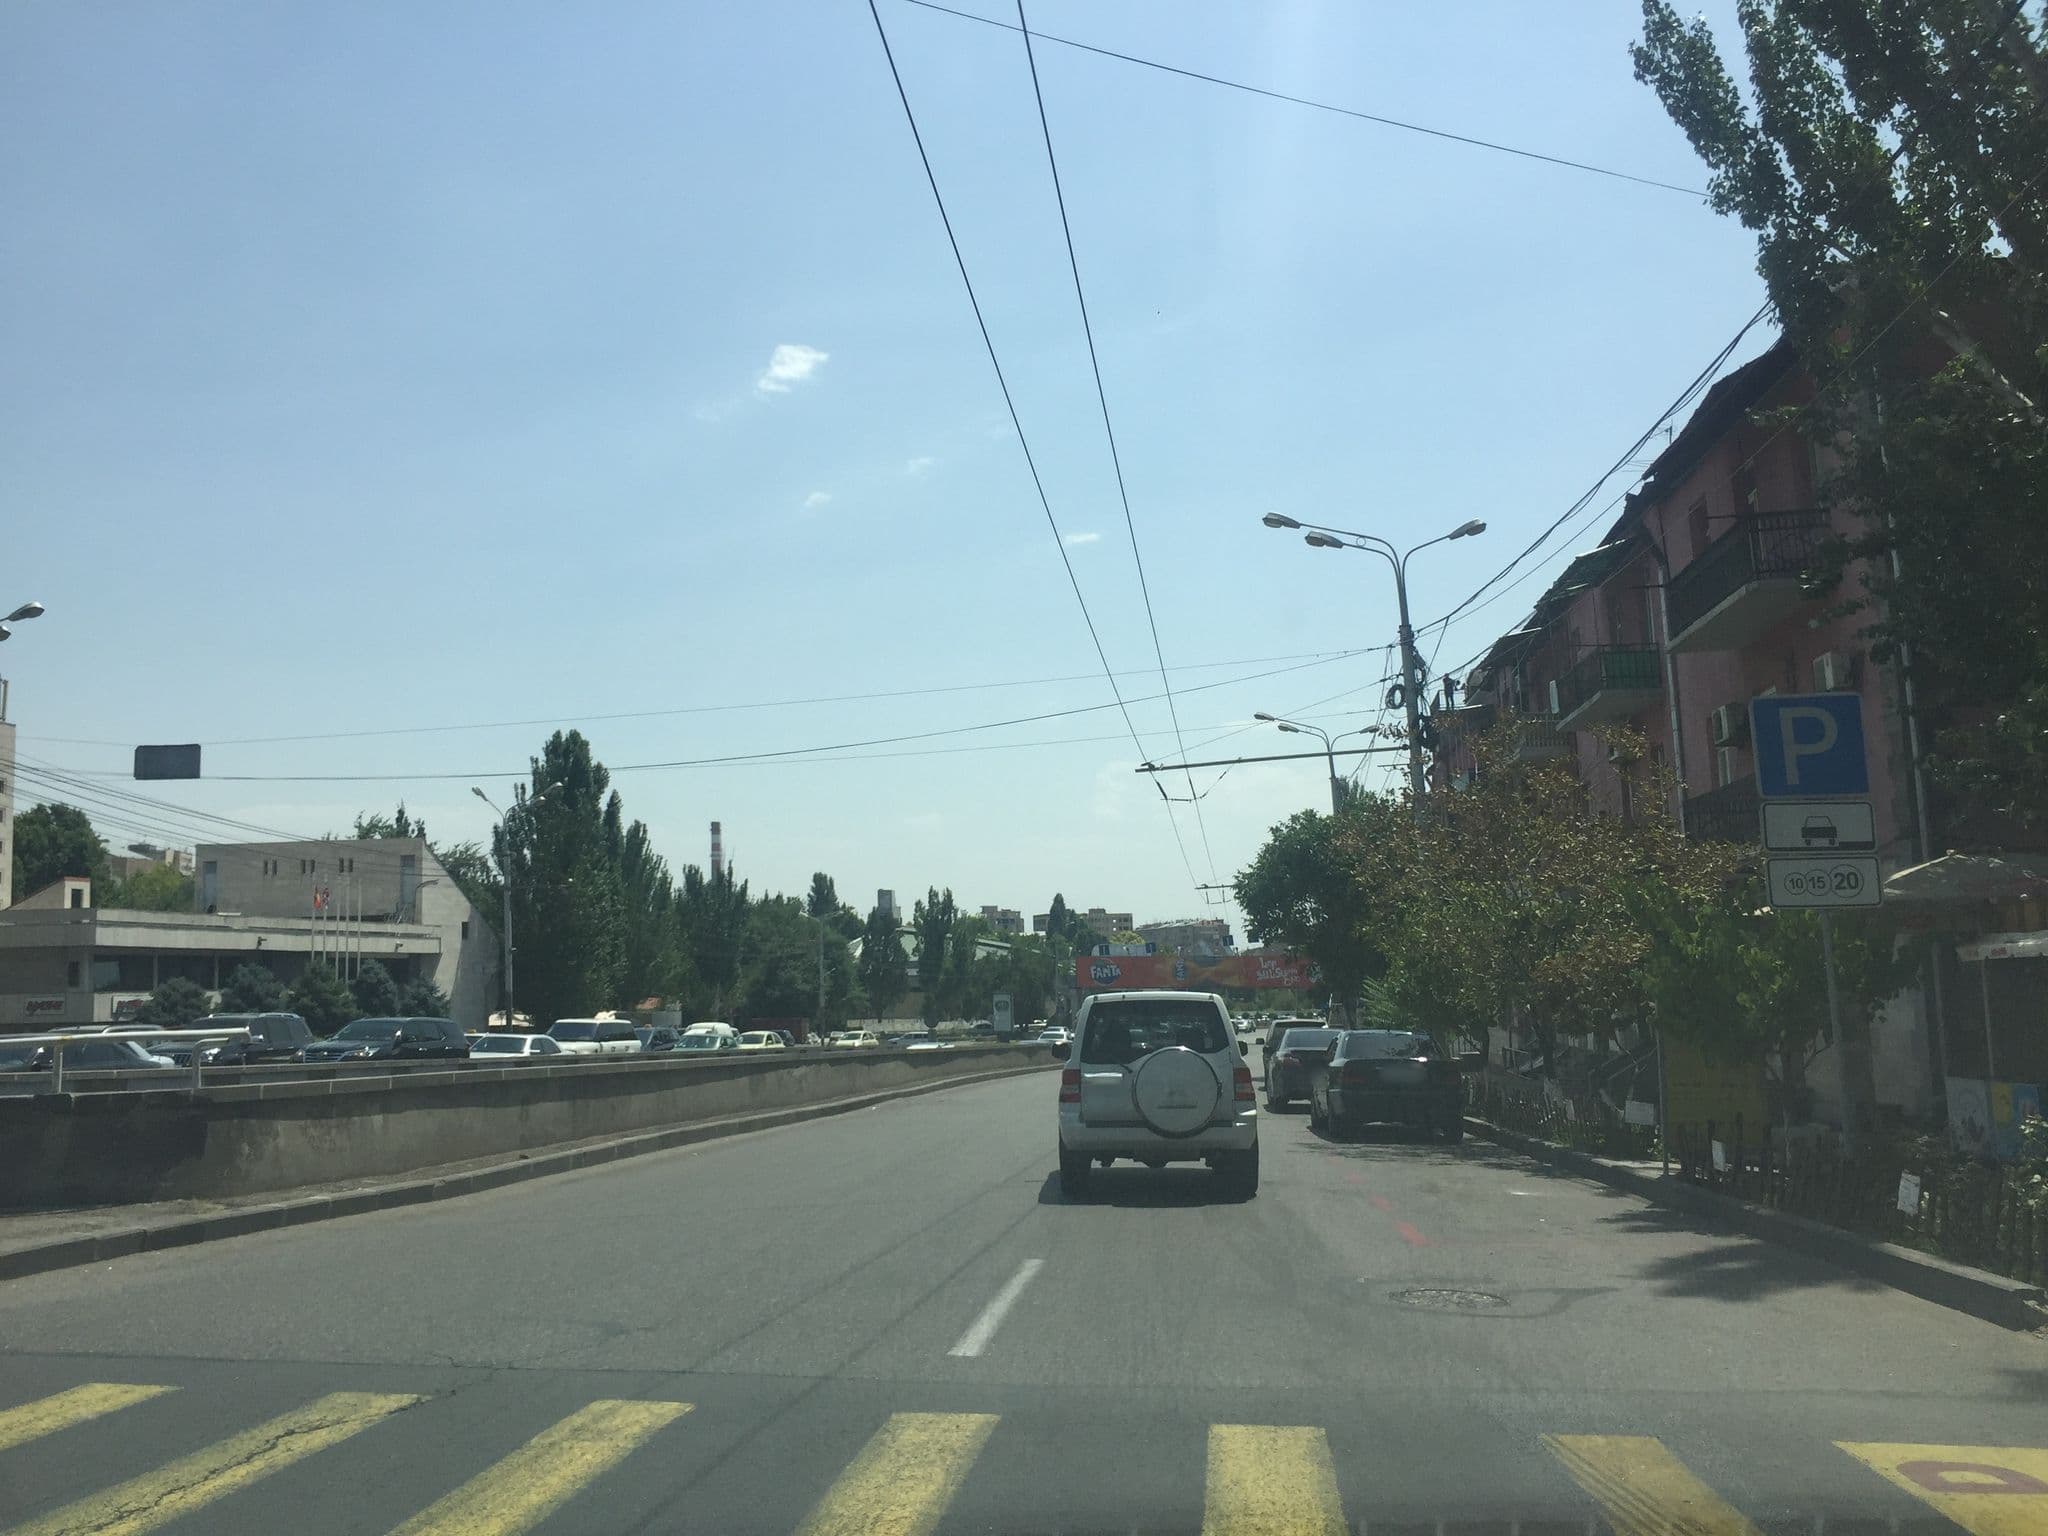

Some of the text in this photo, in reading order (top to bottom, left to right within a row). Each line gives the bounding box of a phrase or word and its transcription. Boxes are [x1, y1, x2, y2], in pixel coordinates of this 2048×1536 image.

[1779, 707, 1838, 785] P
[1788, 871, 1859, 890] 10 15 20
